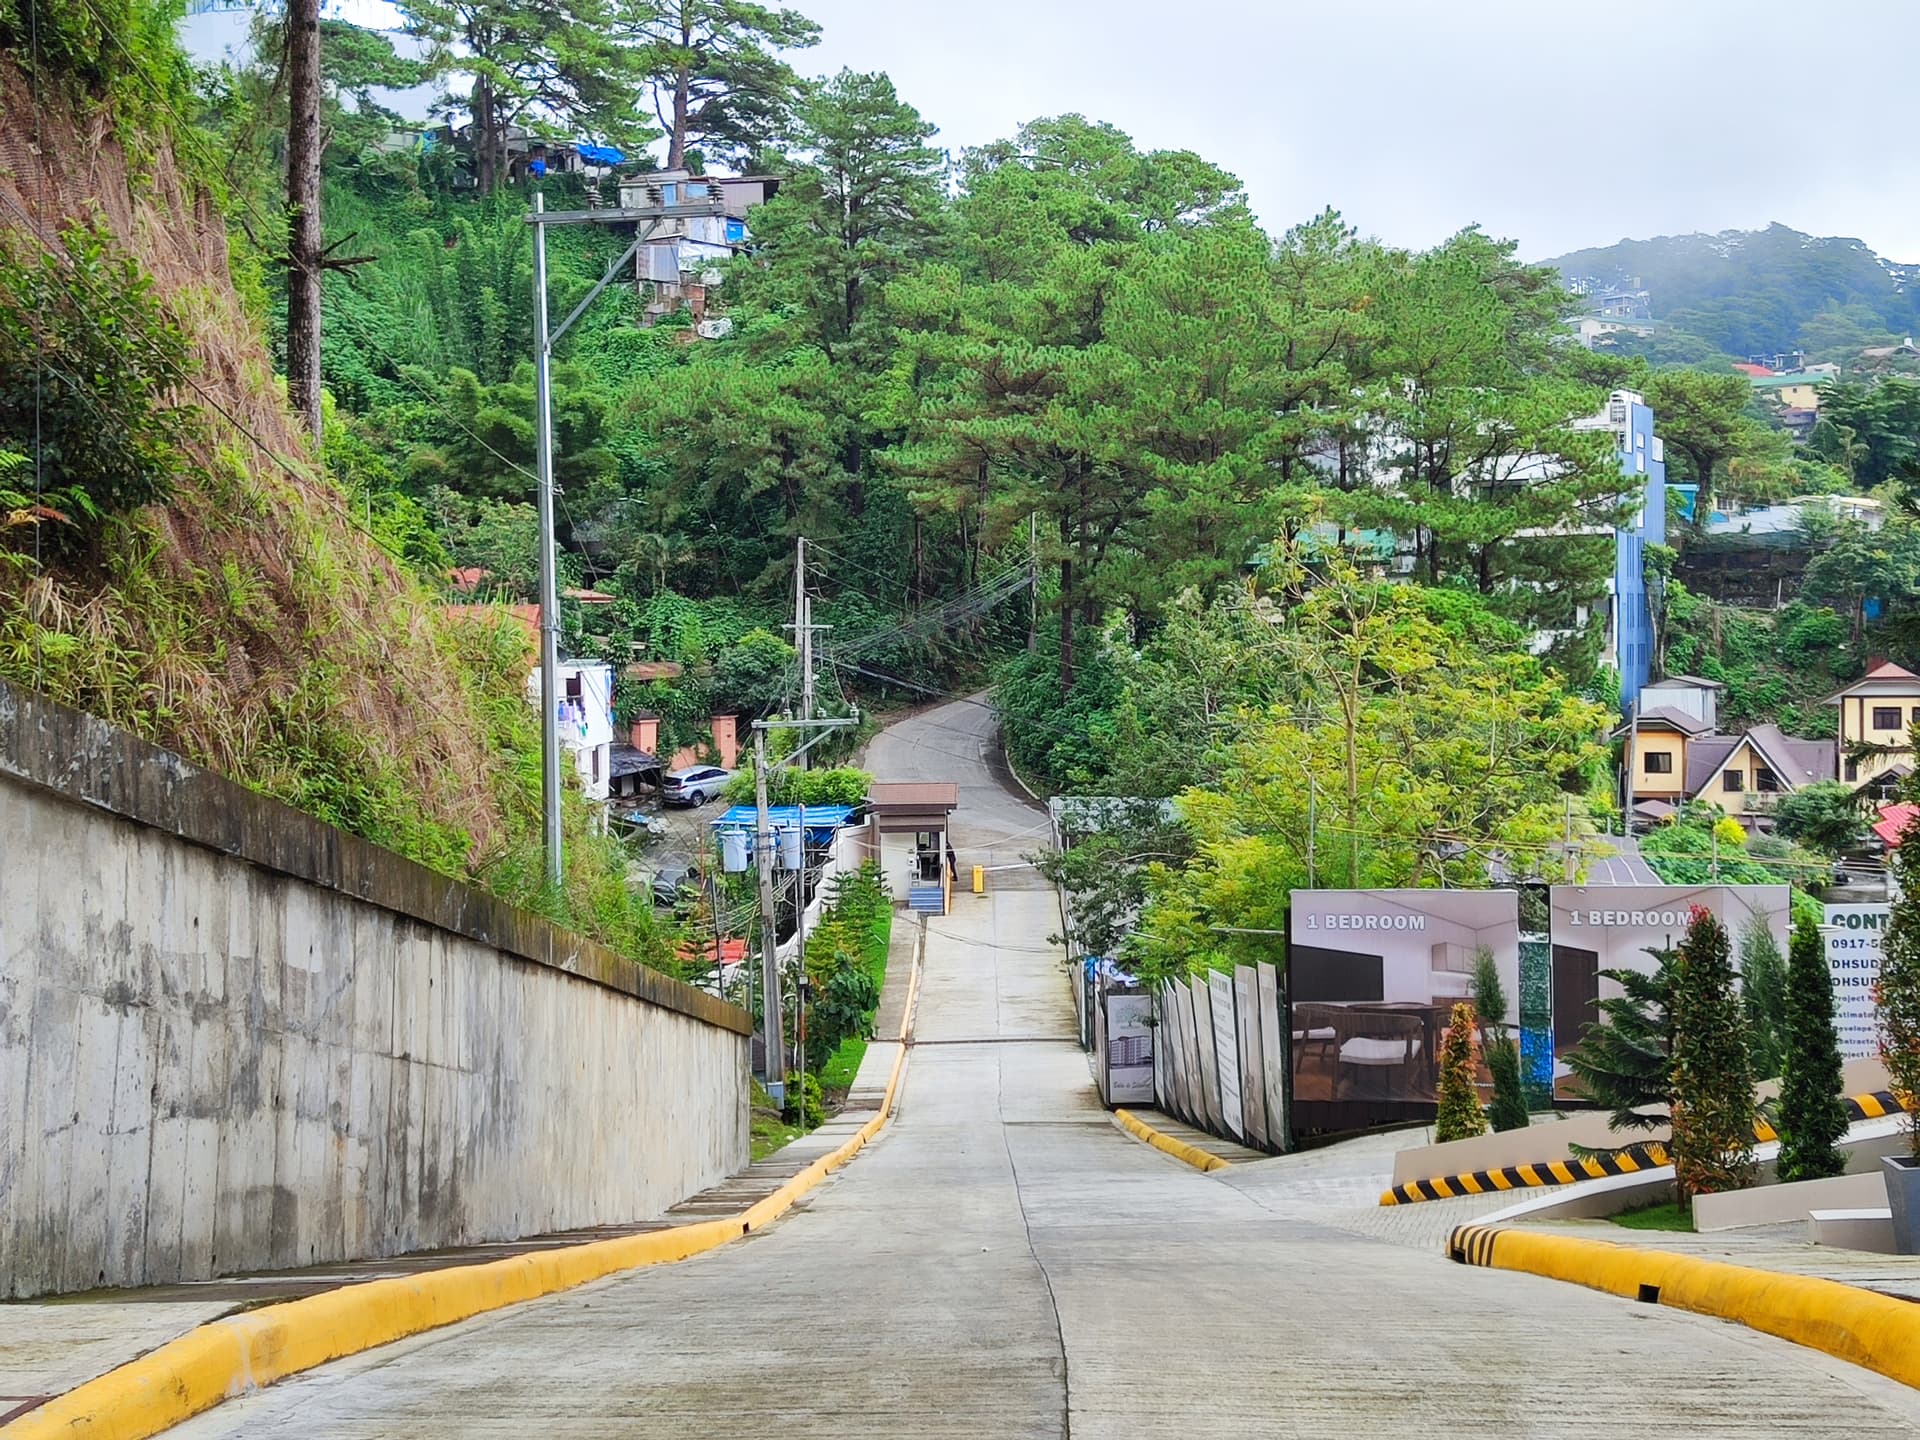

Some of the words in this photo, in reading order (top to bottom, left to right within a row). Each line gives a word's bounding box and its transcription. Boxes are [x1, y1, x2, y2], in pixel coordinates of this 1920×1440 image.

[1307, 915, 1318, 929] 1
[1325, 915, 1425, 930] BEDROOM
[1570, 910, 1582, 925] 1
[1589, 911, 1694, 926] BEDROOM
